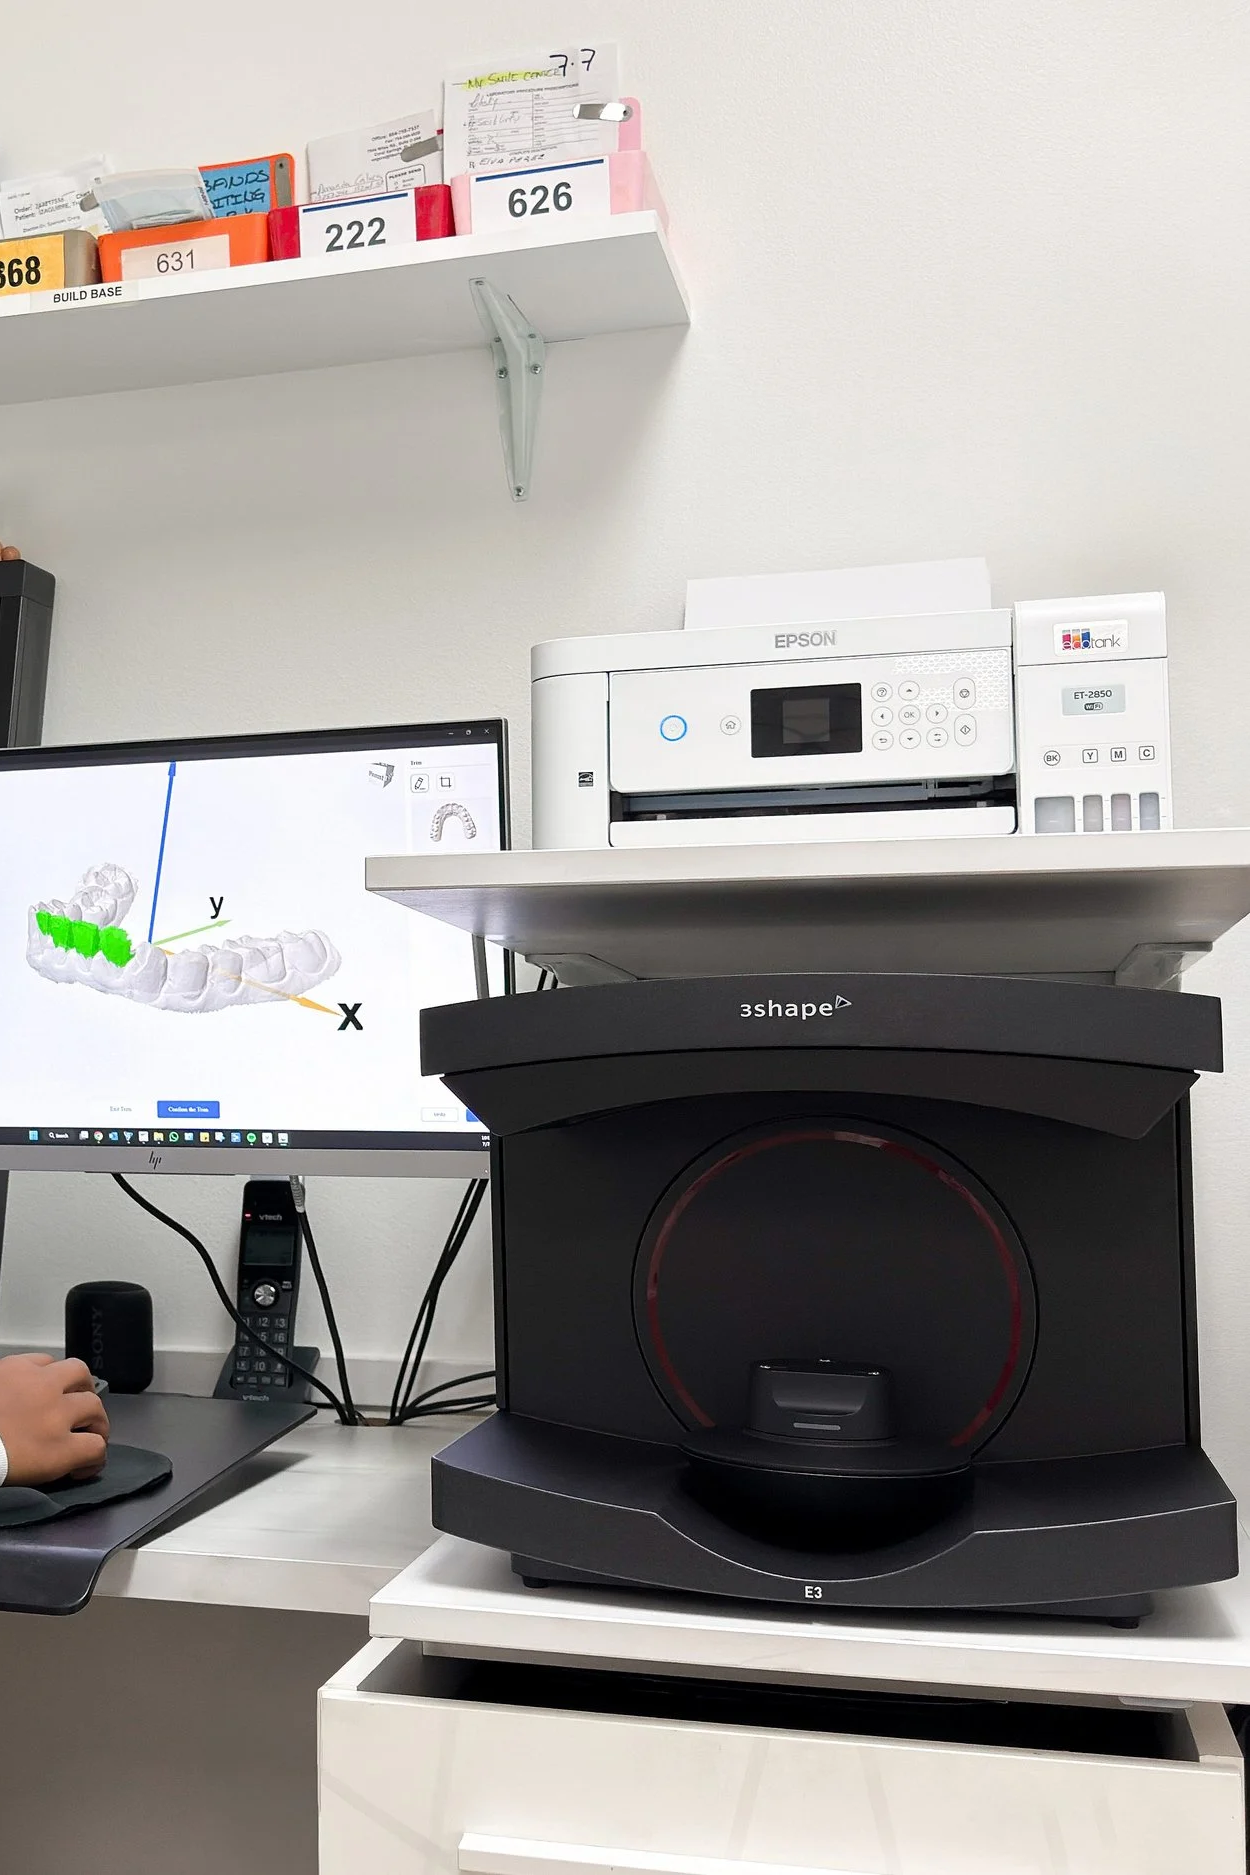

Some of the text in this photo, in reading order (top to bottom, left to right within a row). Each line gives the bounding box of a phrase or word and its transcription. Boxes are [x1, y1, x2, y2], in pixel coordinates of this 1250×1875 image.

[508, 182, 573, 218] 626
[325, 217, 386, 253] 222
[156, 249, 195, 273] 631
[53, 286, 123, 304] BUILD BASE
[774, 630, 837, 649] EPSON
[1073, 689, 1113, 700] ET-2850
[1046, 754, 1058, 763] BK
[1114, 750, 1123, 759] M
[1142, 749, 1151, 758] C
[209, 896, 224, 919] y
[740, 999, 833, 1021] 3shape
[259, 1214, 282, 1222] vtech
[91, 1305, 103, 1370] SONY
[804, 1585, 823, 1599] E3
